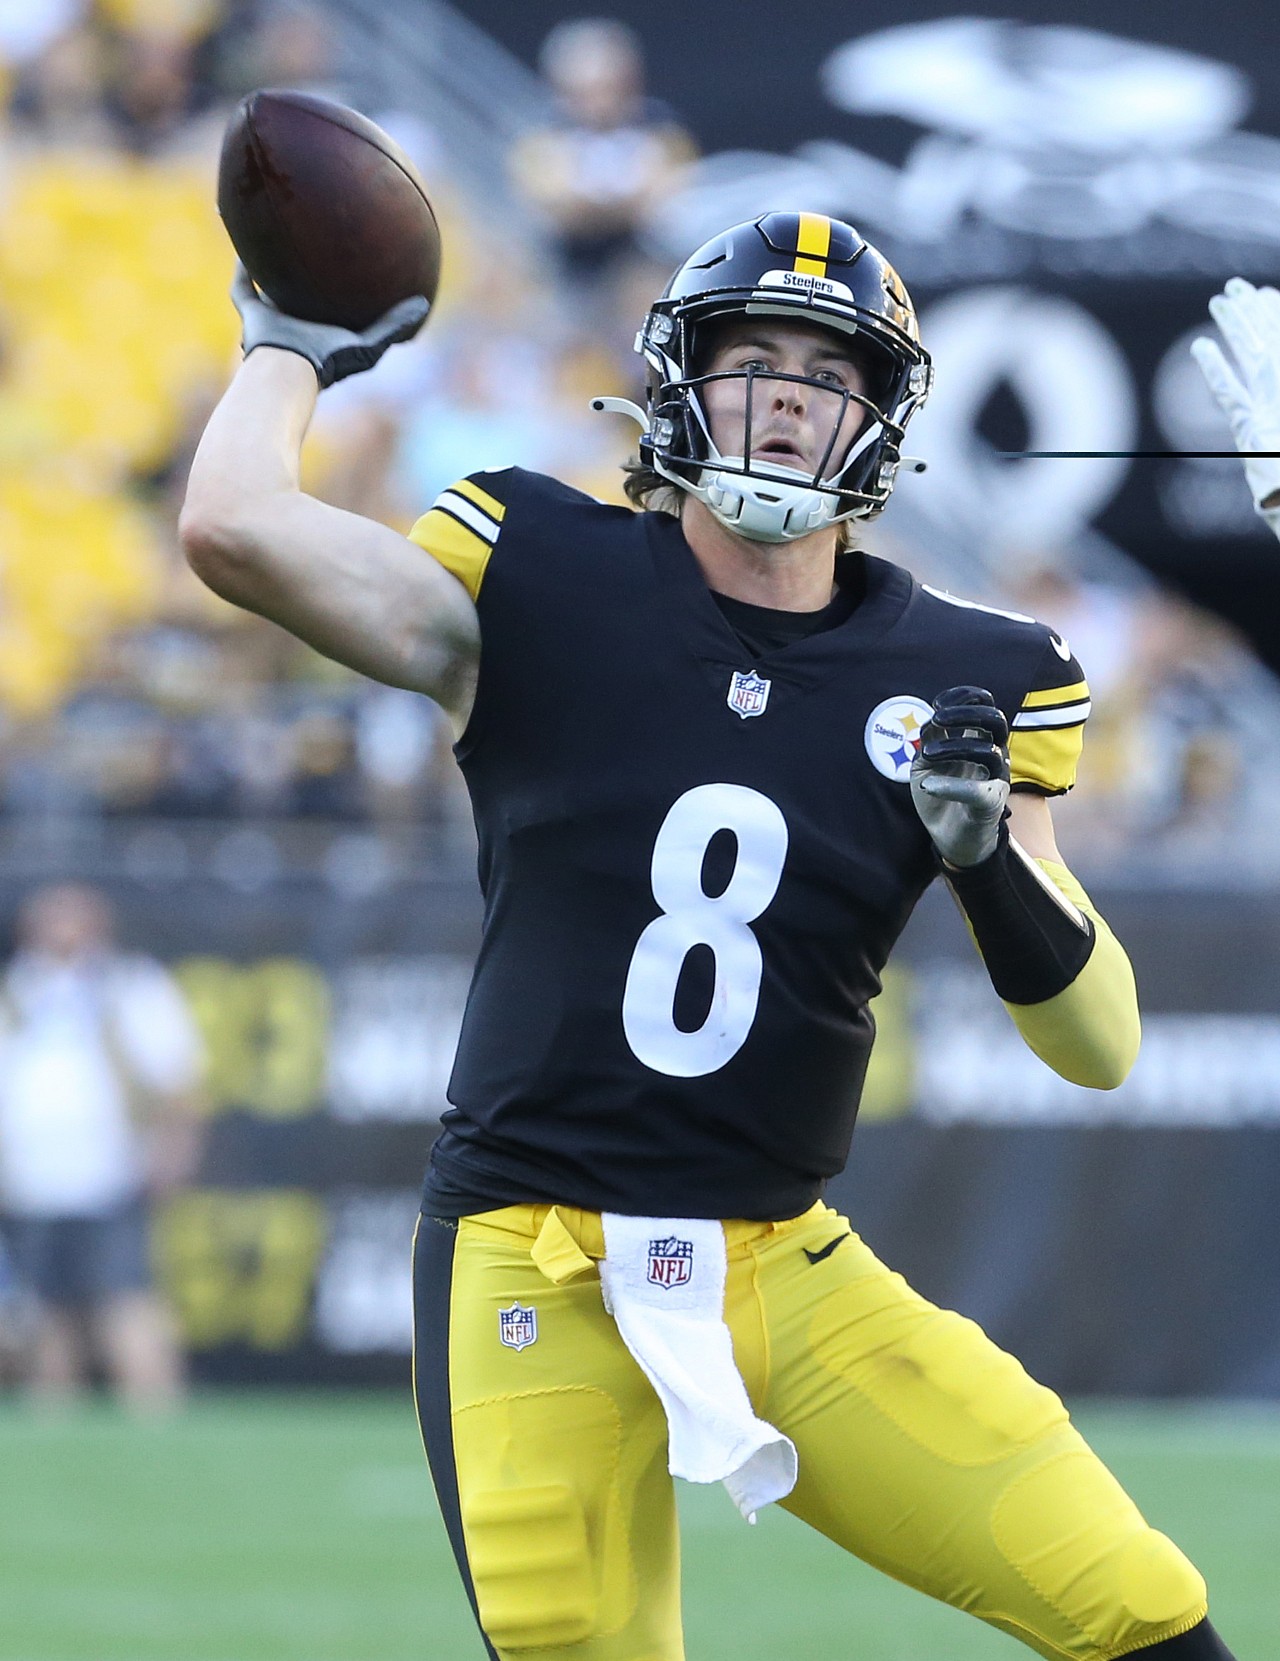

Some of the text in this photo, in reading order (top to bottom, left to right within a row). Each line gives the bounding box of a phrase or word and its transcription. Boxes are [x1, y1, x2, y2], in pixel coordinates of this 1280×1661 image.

[783, 273, 834, 294] Steelers
[734, 690, 759, 710] NFL
[873, 723, 904, 742] Steelers
[622, 783, 789, 1078] 8
[650, 1258, 688, 1284] NFL
[505, 1325, 531, 1341] NFL
